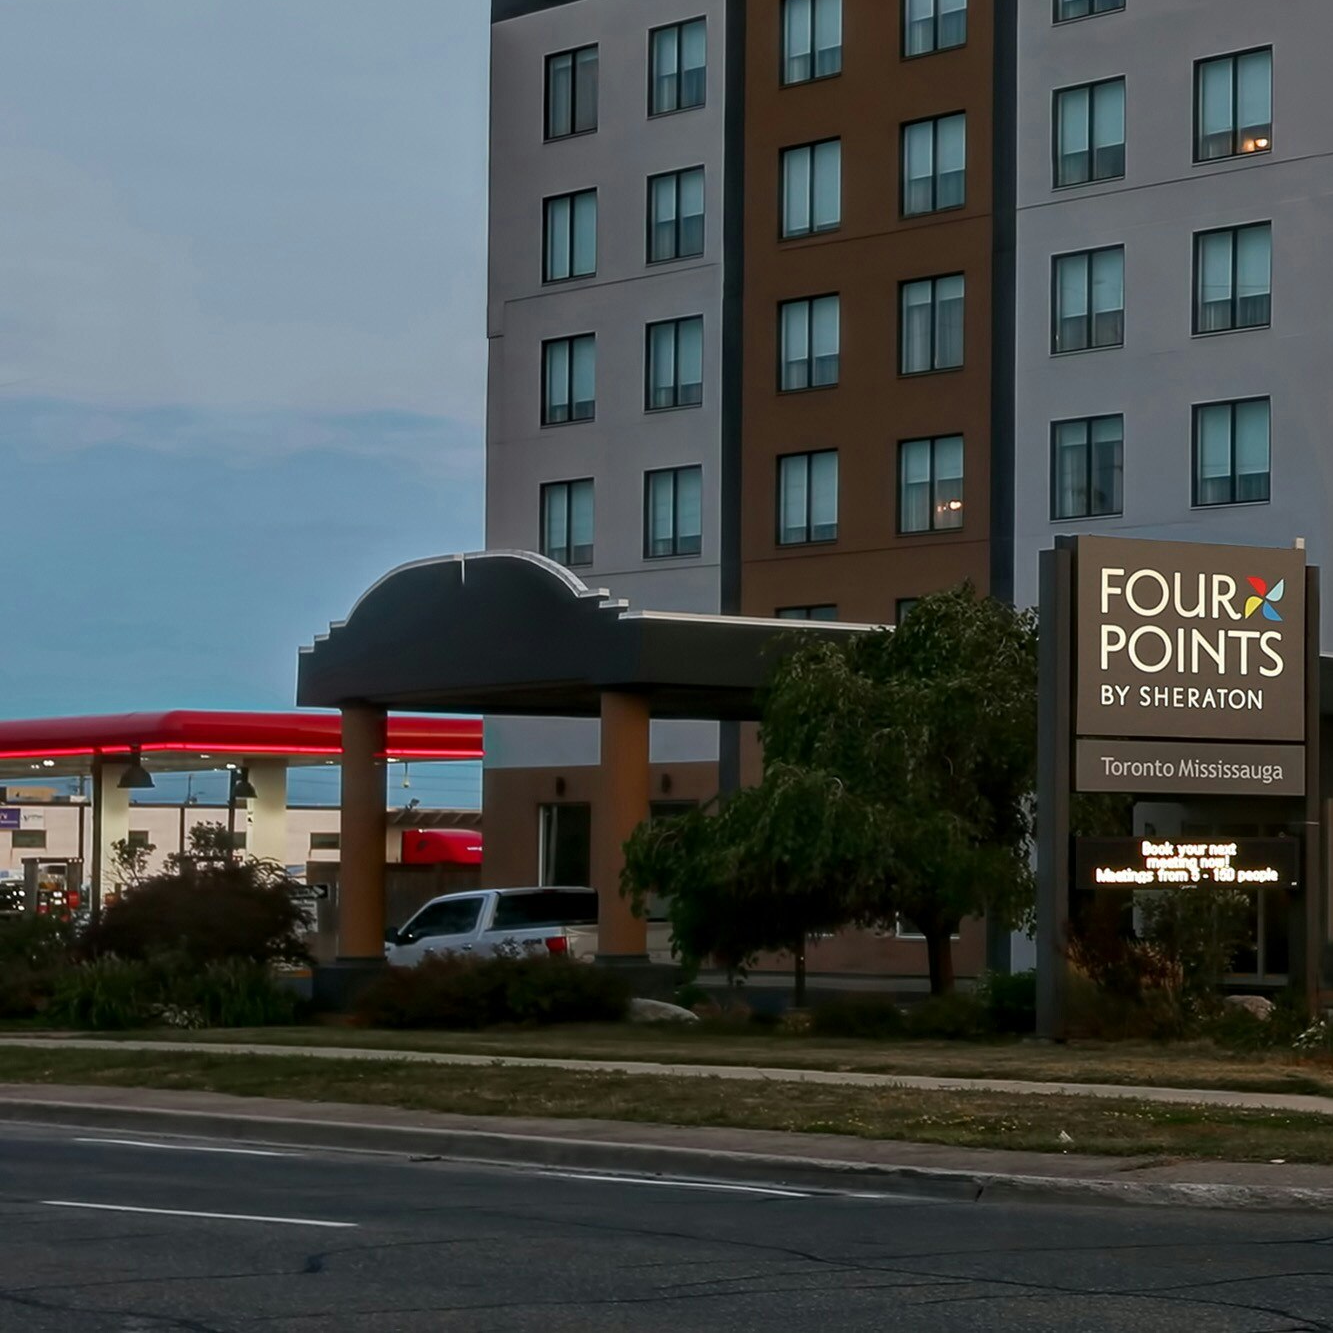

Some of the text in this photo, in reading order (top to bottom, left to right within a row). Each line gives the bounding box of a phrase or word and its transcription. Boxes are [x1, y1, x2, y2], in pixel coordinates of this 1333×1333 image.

[1101, 568, 1242, 620] FOUR
[1100, 624, 1284, 677] POINTS
[1101, 685, 1263, 710] BY SHERATON
[1101, 756, 1283, 784] Toronto Mississauga
[1142, 841, 1237, 859] Book your next
[1096, 867, 1154, 884] Meetings
[1157, 868, 1189, 882] from
[1237, 867, 1278, 883] people
[1146, 854, 1230, 872] meeting now!
